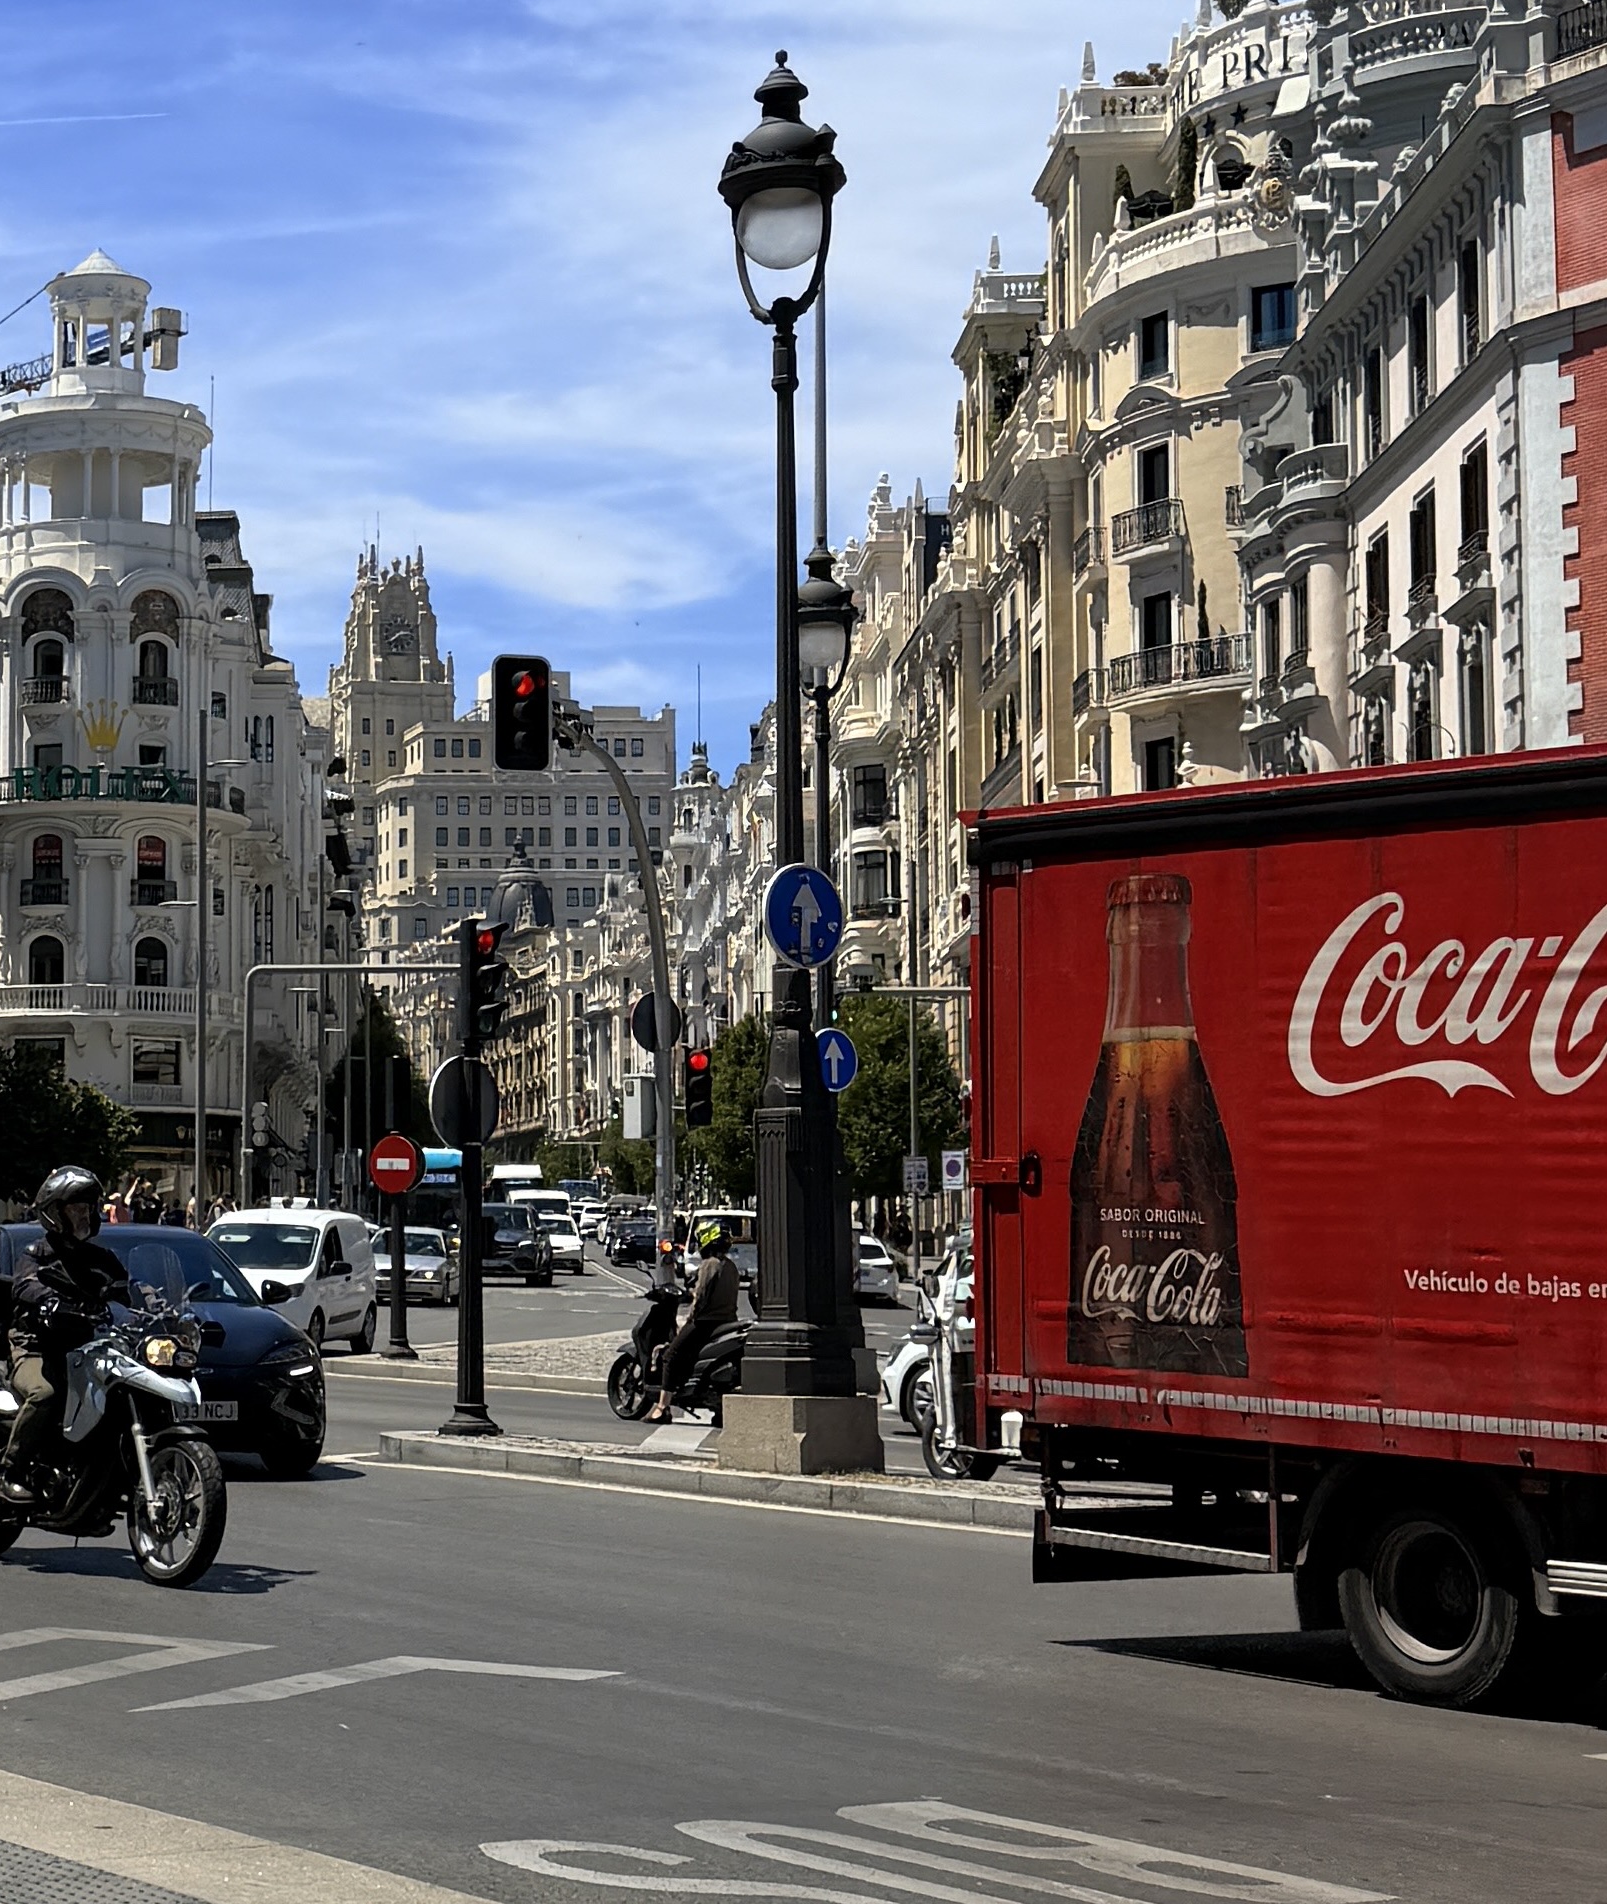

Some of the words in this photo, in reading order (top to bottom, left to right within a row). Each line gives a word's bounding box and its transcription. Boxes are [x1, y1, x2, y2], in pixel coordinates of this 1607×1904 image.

[13, 765, 190, 803] ROLEX
[1100, 1208, 1140, 1222] SABOR
[1144, 1208, 1206, 1224] ORIGINAL
[1082, 1245, 1224, 1325] Coca-Cola
[1404, 1269, 1488, 1293] Vehículo
[1494, 1272, 1521, 1295] de
[1527, 1272, 1582, 1303] bajas
[204, 1403, 234, 1418] NCJ
